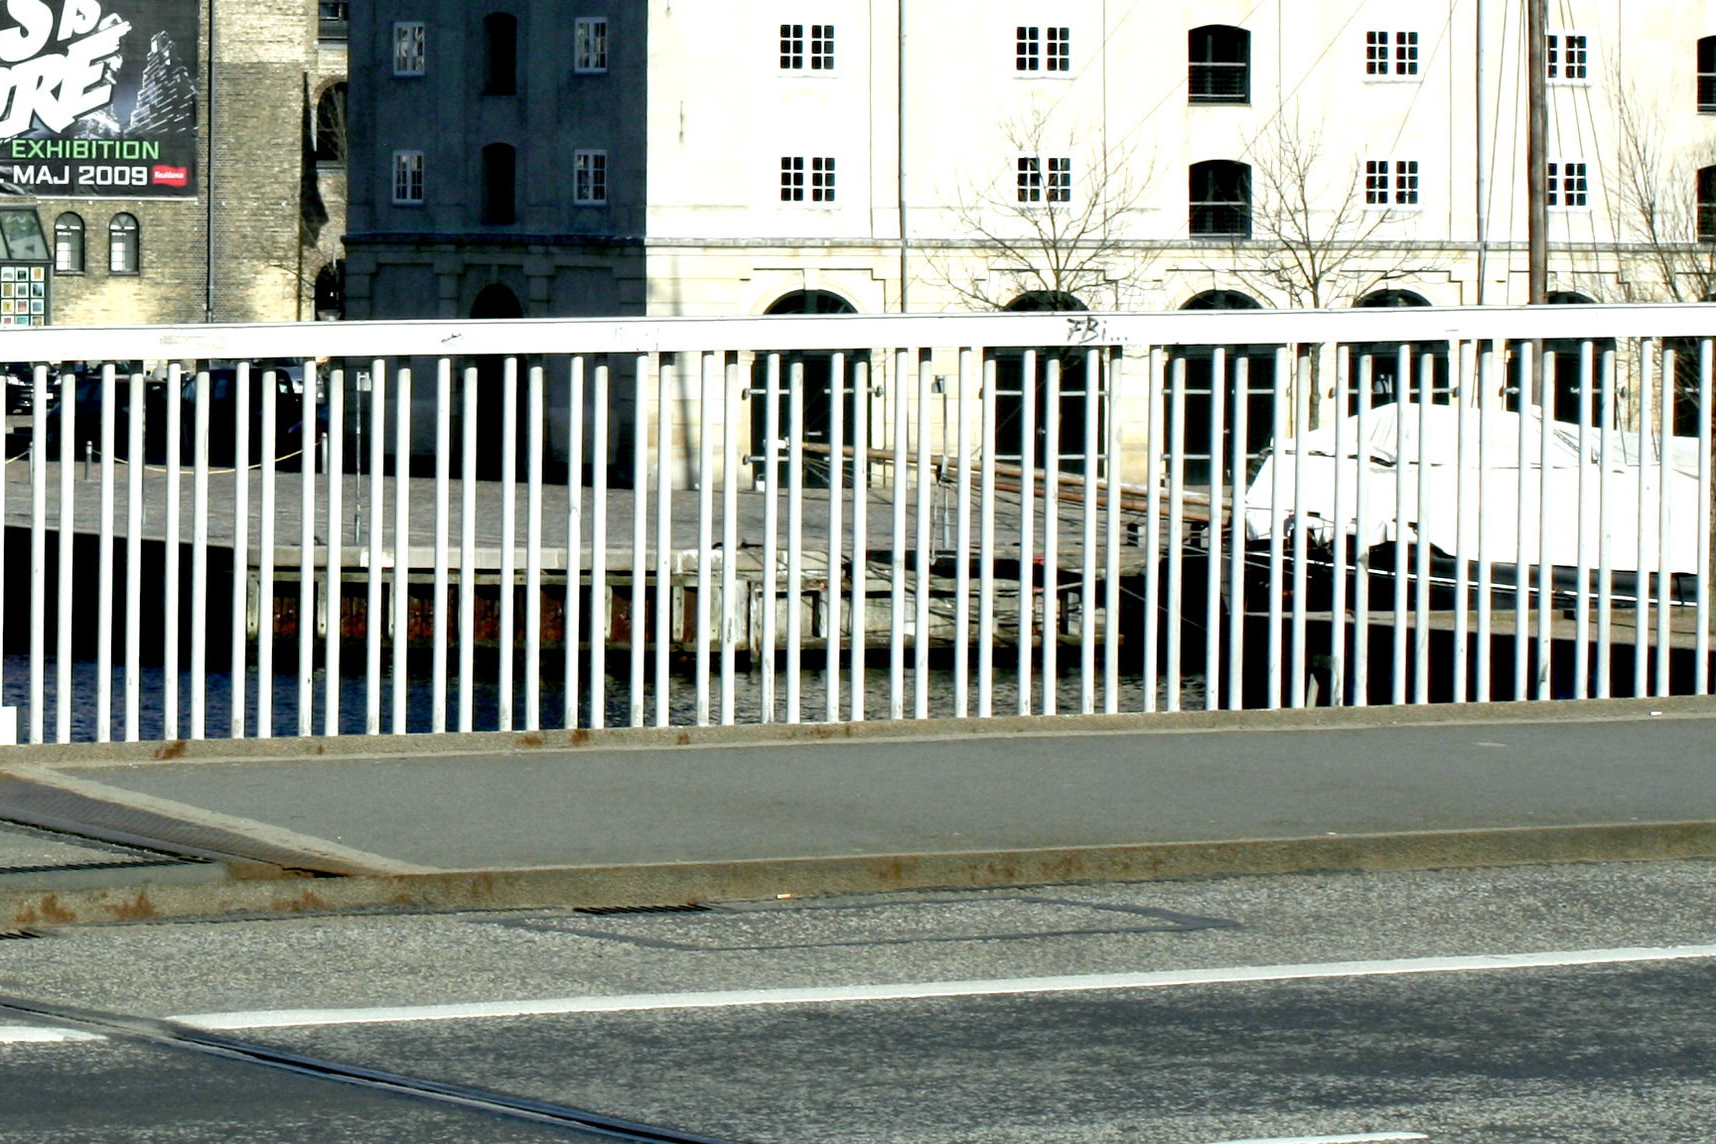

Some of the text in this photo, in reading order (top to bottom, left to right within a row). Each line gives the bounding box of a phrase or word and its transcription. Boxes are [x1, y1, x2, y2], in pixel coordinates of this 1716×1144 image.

[11, 140, 160, 159] EXHIBITION
[13, 165, 70, 185] MAJ
[78, 166, 148, 186] 2009
